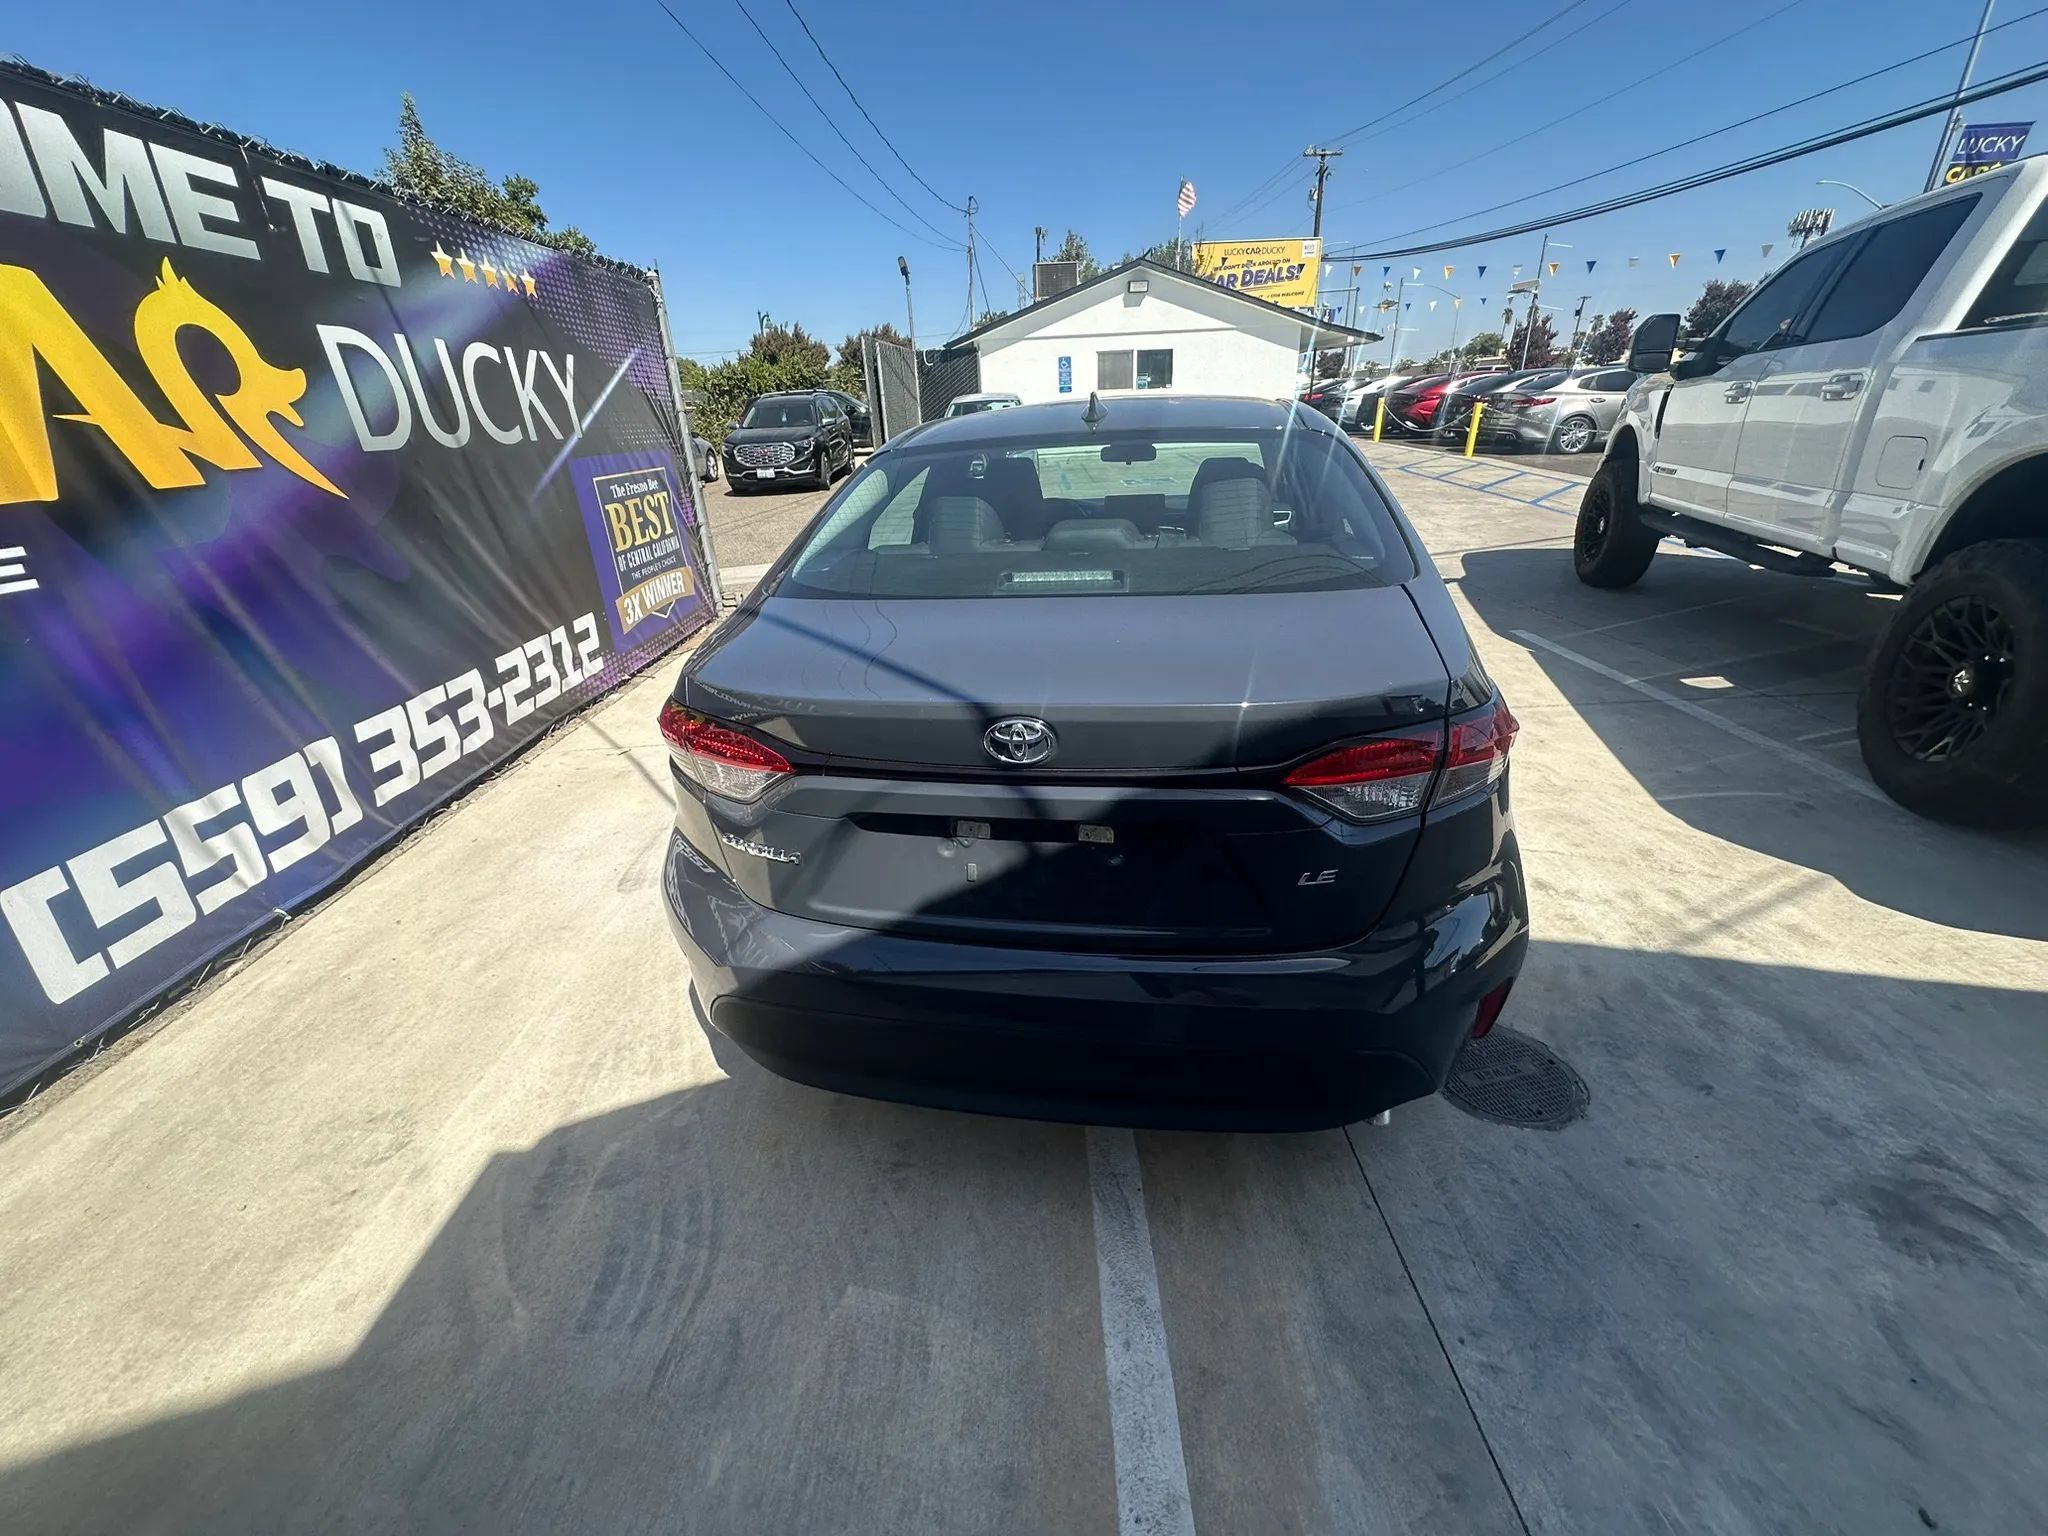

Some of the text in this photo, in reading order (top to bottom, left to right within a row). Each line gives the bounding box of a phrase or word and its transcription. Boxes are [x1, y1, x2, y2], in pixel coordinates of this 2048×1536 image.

[1956, 135, 2026, 155] LUCKY
[261, 176, 401, 288] TO
[1240, 263, 1304, 288] DEALS!
[316, 324, 584, 452] DUCKY
[610, 478, 659, 498] The Fresno Bee
[604, 491, 673, 552] BEST
[617, 535, 680, 572] OF CENTRAL CALIFORNIA
[631, 569, 641, 580] THE
[661, 555, 676, 568] CHOICE
[623, 571, 685, 625] 3X WINNER
[353, 611, 604, 808] 353-2312
[1297, 869, 1339, 886] LE
